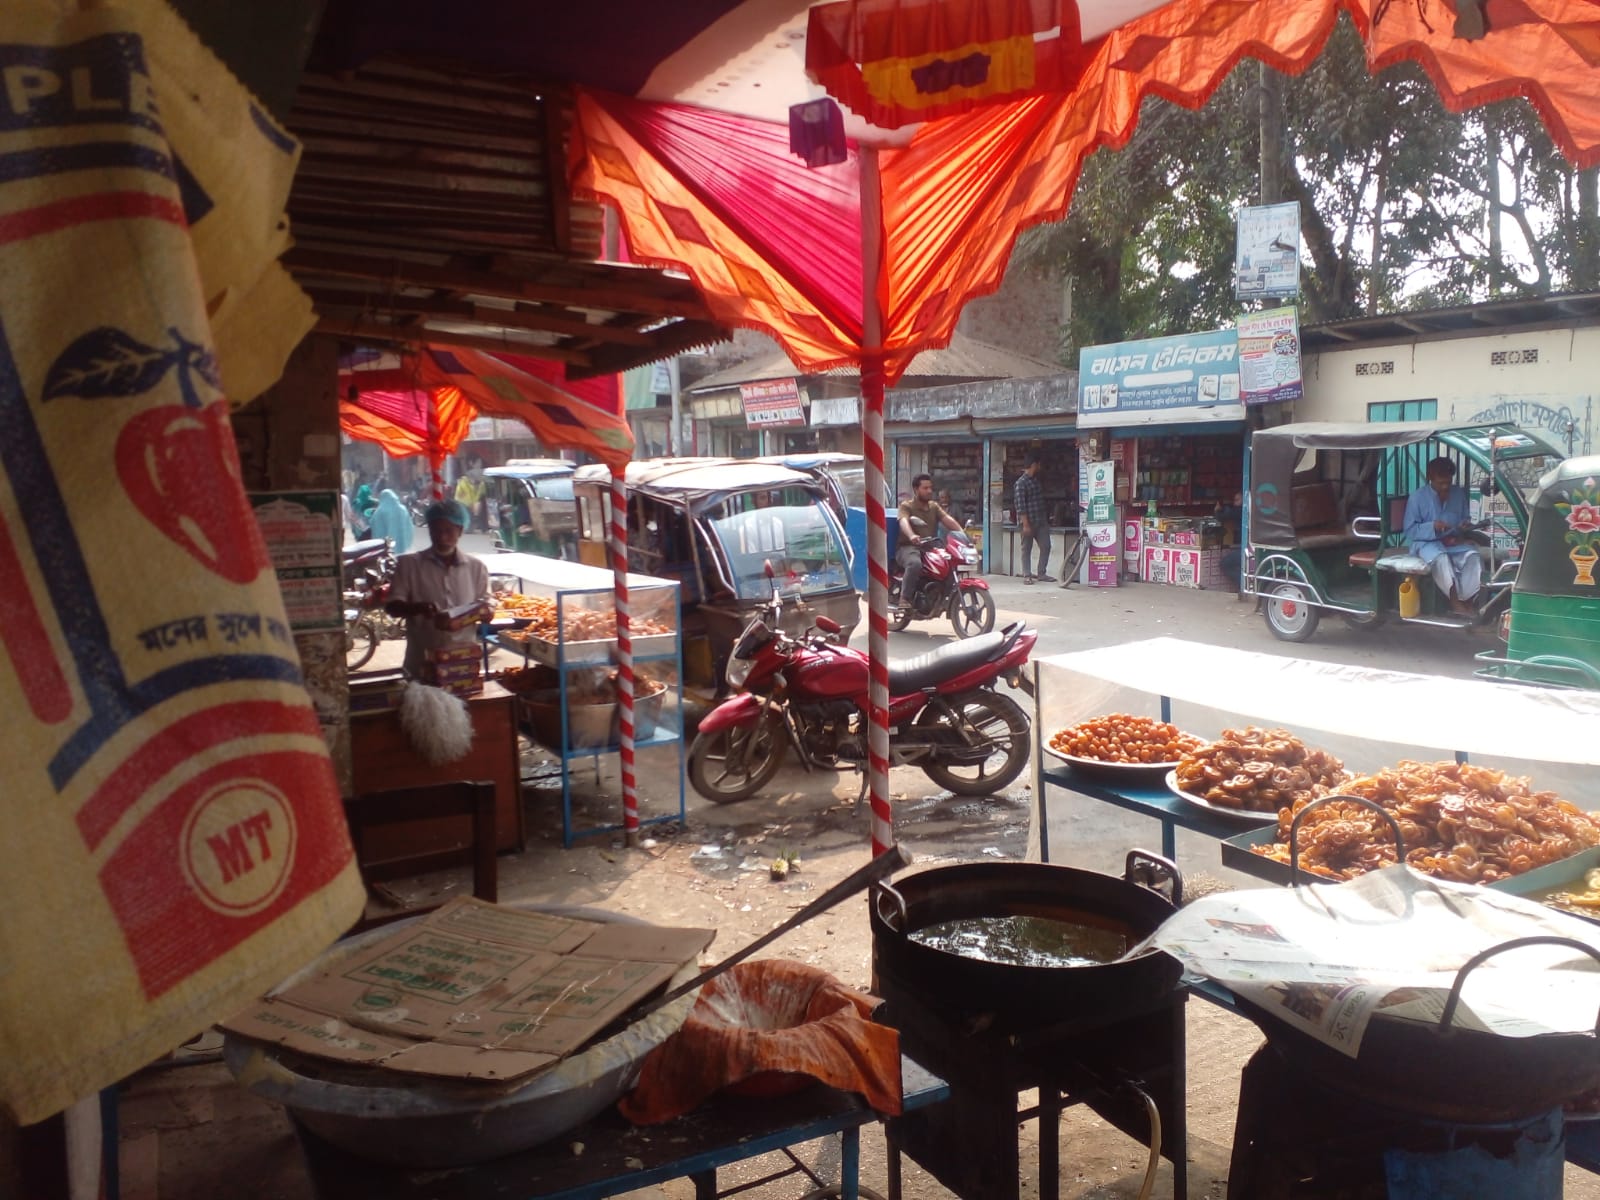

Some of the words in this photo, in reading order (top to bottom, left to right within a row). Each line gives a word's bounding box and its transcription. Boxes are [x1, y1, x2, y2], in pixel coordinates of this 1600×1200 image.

[1091, 354, 1147, 375] রাসেল
[1152, 344, 1237, 371] টেলিকম
[137, 617, 208, 651] মনের
[206, 809, 272, 884] MT
